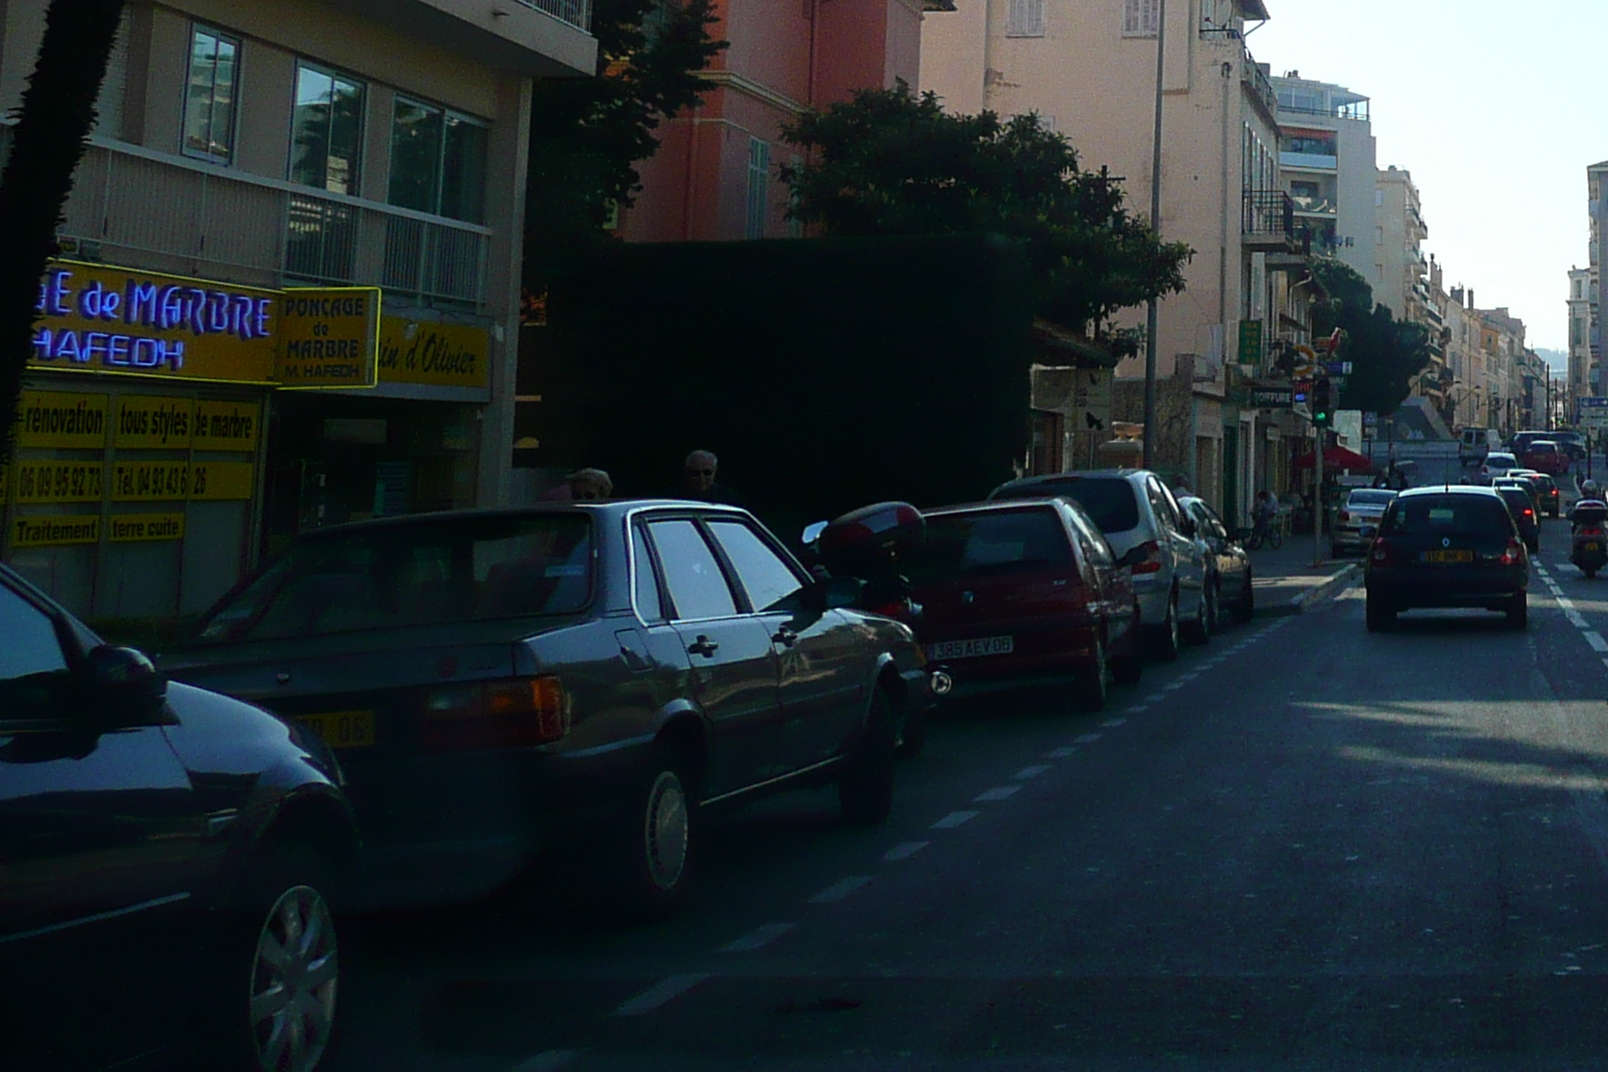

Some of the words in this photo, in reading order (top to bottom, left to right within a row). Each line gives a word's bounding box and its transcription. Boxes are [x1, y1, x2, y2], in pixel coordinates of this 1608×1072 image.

[79, 278, 121, 321] de
[124, 277, 275, 341] MARBRE
[312, 321, 329, 336] de
[286, 339, 359, 359] MARBRE
[25, 399, 103, 435] rénovation
[119, 405, 148, 435] tous
[151, 406, 188, 443] styles
[210, 409, 253, 439] marbre
[16, 520, 97, 542] Traitement
[112, 519, 145, 538] terre
[147, 518, 180, 536] cuite
